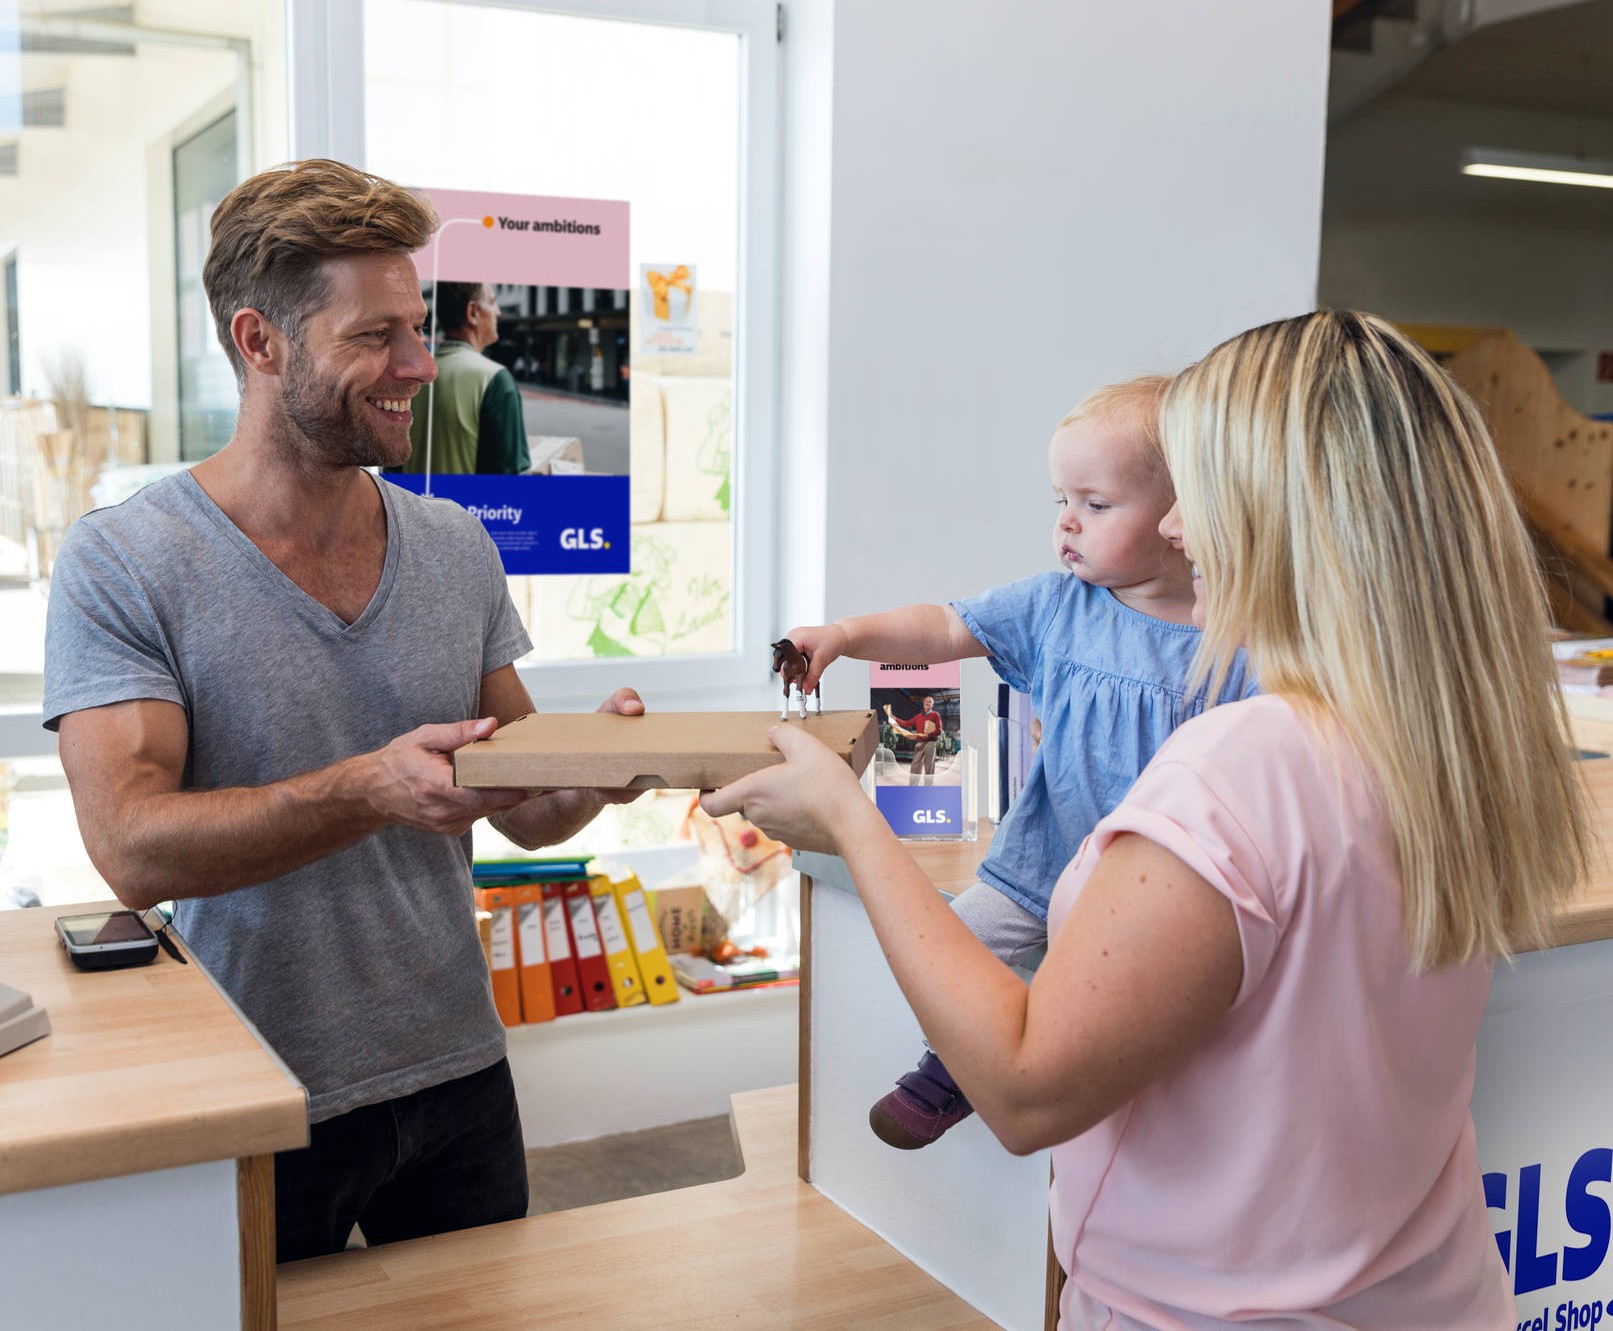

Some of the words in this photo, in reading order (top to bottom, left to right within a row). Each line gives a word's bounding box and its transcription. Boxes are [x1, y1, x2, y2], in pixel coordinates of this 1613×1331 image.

[498, 216, 530, 232] Your
[532, 219, 601, 236] ambitions
[467, 504, 522, 525] Priority
[880, 663, 929, 671] ambitions
[1555, 1299, 1603, 1331] Shop
